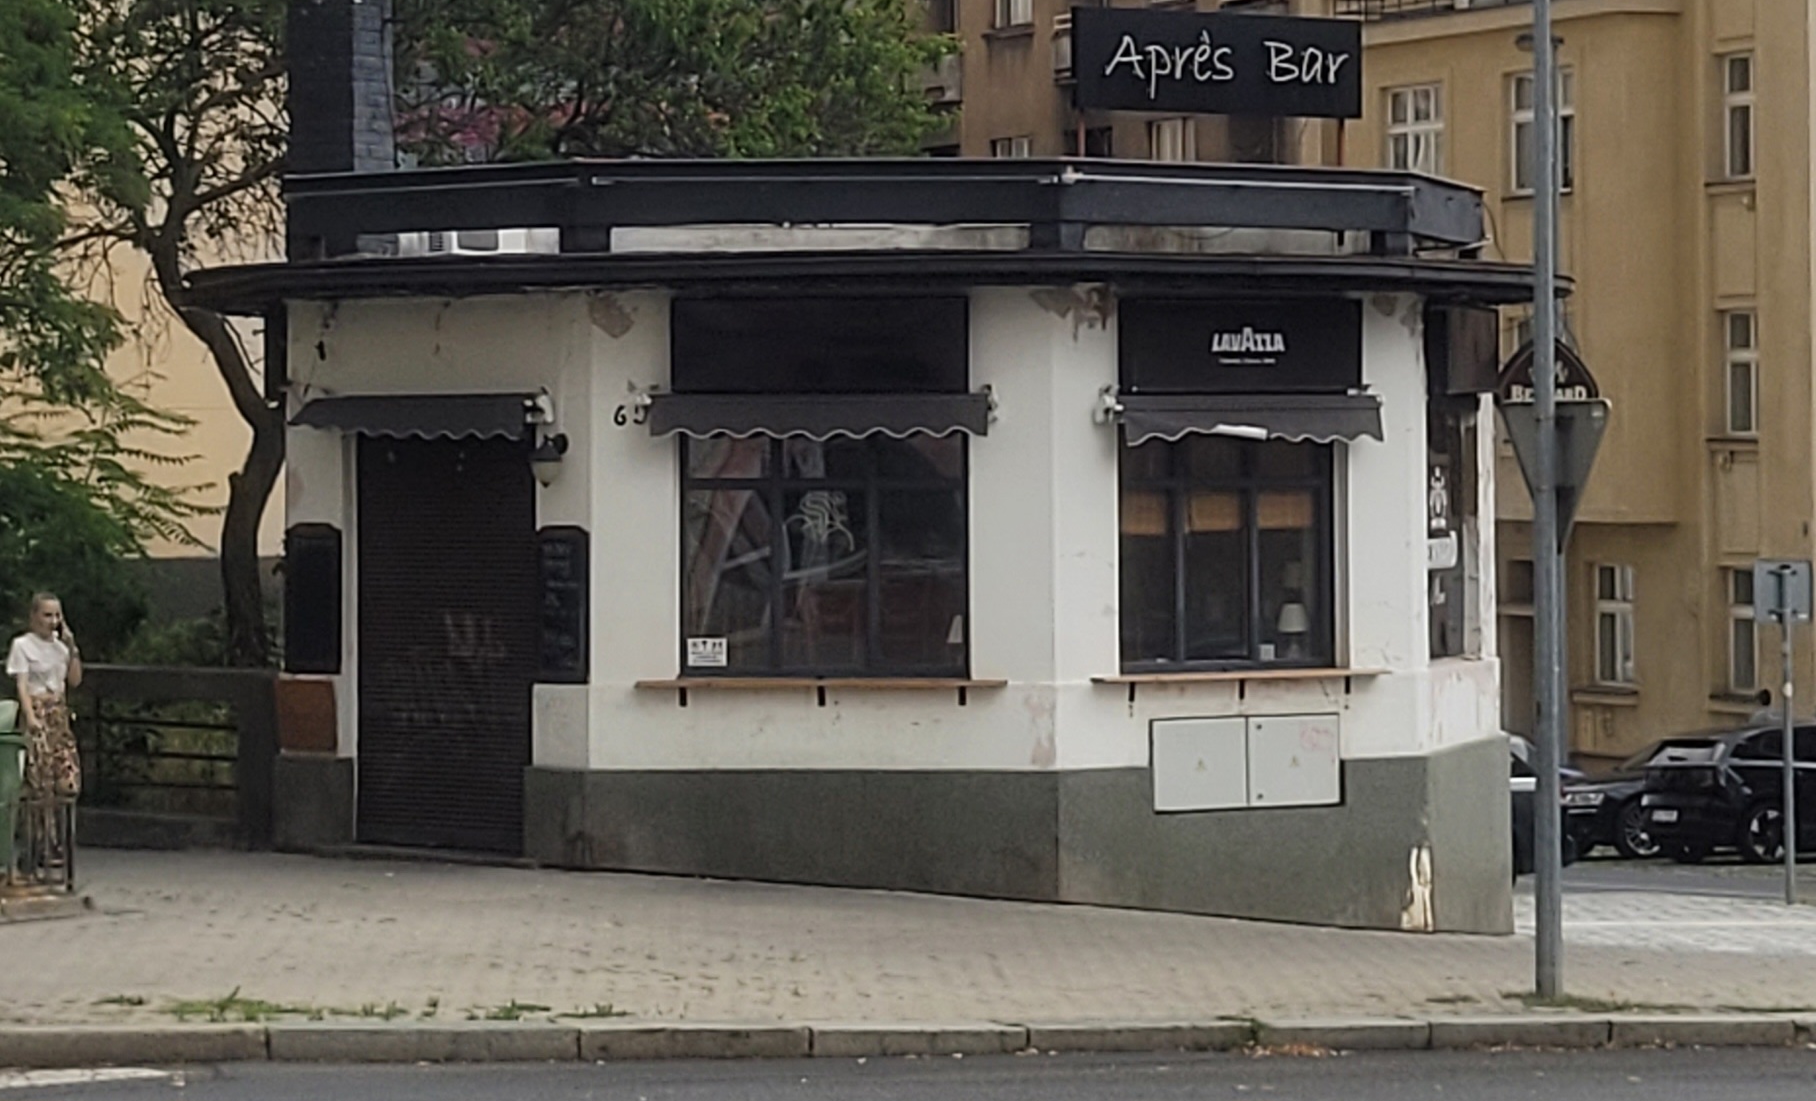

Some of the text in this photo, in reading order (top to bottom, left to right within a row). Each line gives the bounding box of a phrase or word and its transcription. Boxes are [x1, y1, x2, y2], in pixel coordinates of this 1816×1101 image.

[1105, 29, 1349, 100] Après Bar
[1211, 327, 1285, 352] LAVAZZA
[1510, 384, 1587, 400] BEARD
